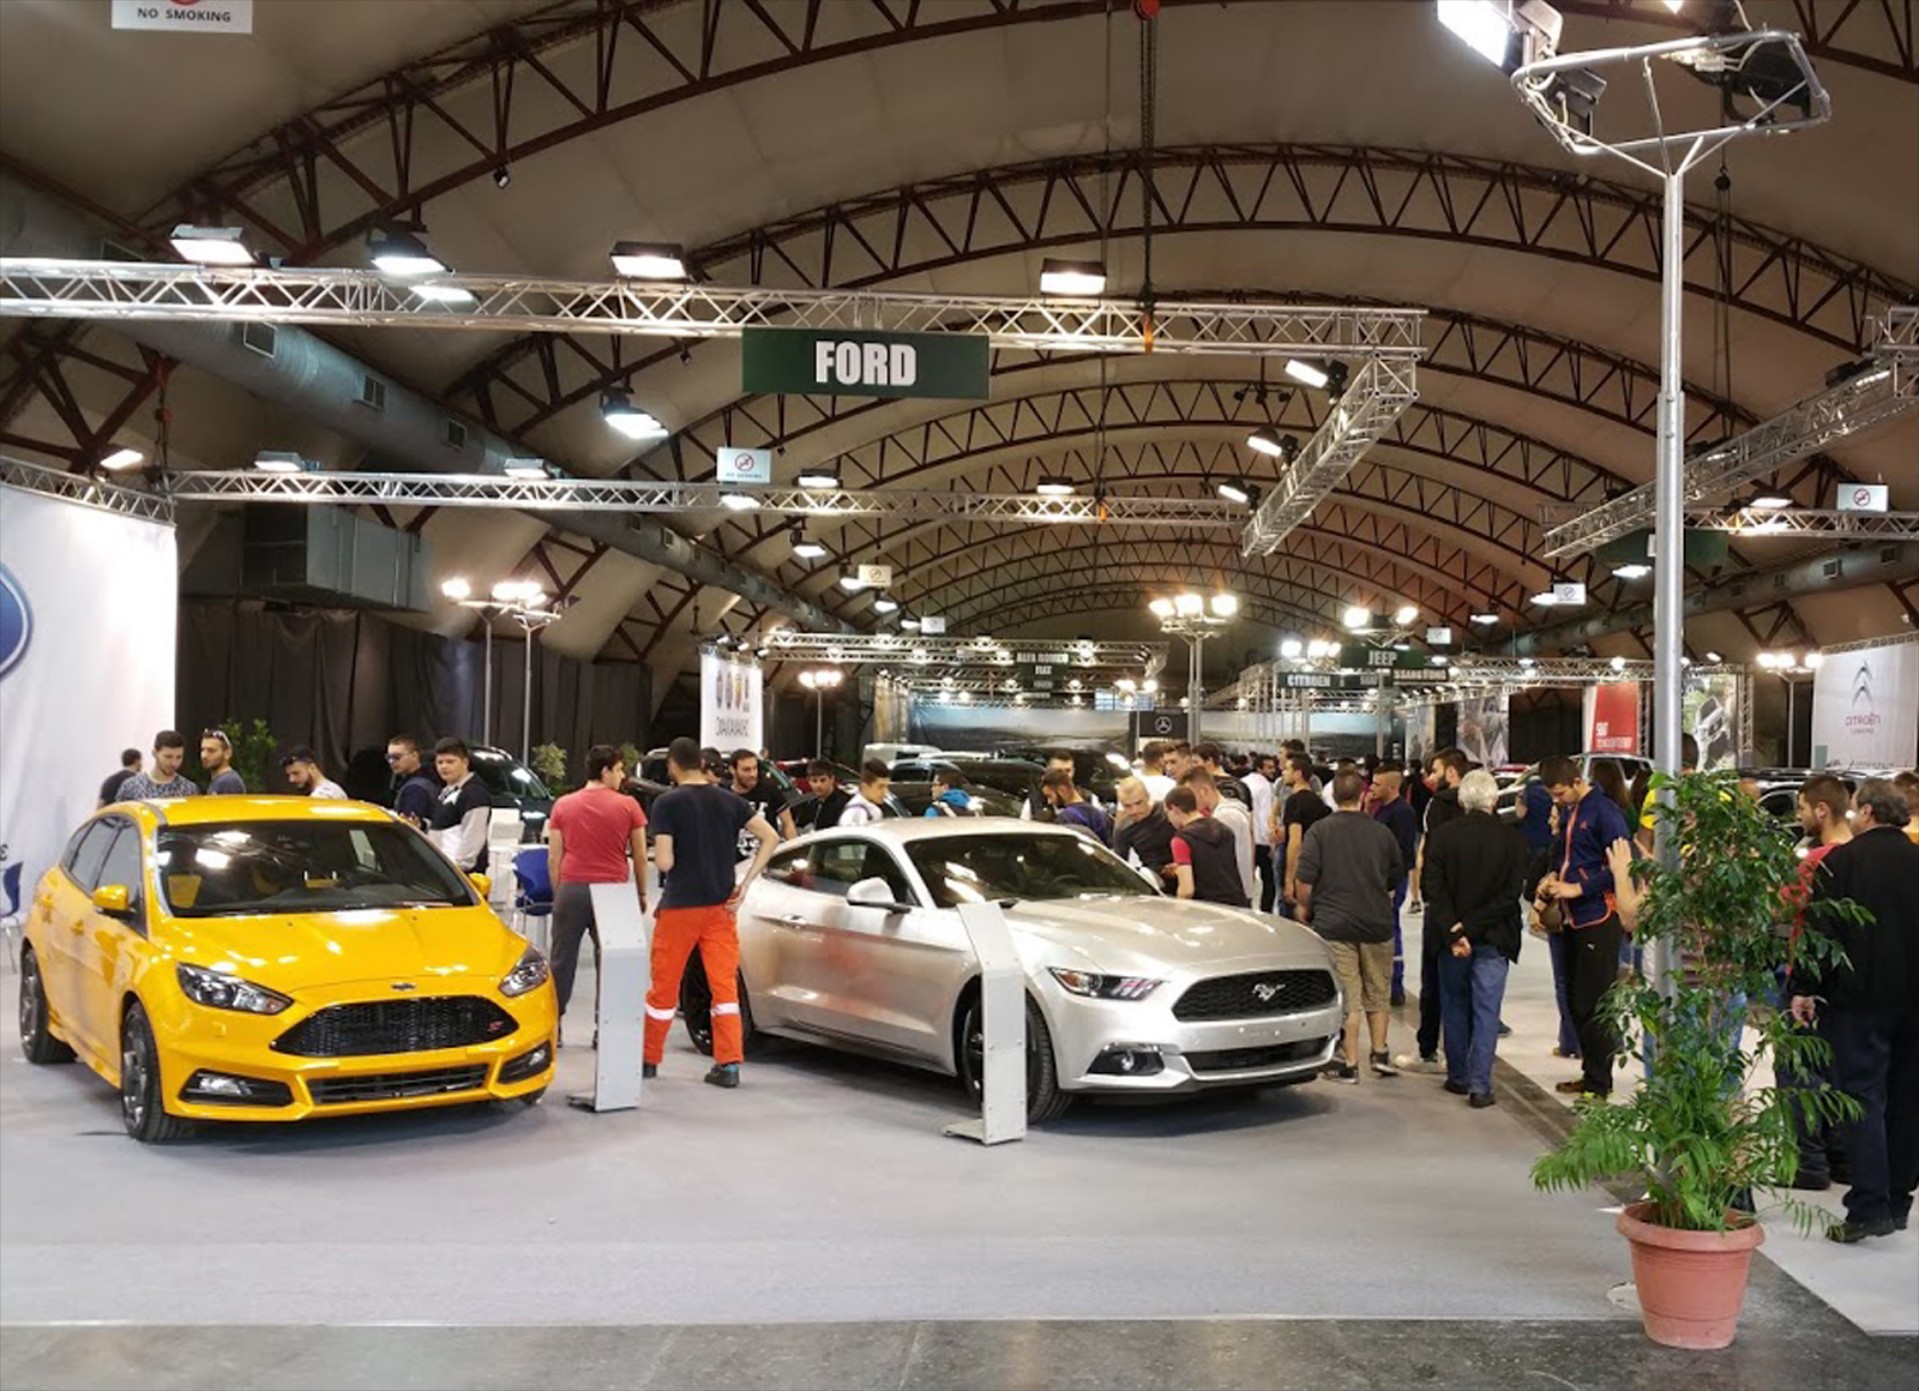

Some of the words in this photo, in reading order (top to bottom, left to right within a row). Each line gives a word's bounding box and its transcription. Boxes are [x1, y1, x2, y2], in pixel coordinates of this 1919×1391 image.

[137, 7, 159, 19] NO
[165, 9, 231, 23] SMOKING
[815, 340, 917, 386] FORD
[1368, 650, 1397, 666] JEEP
